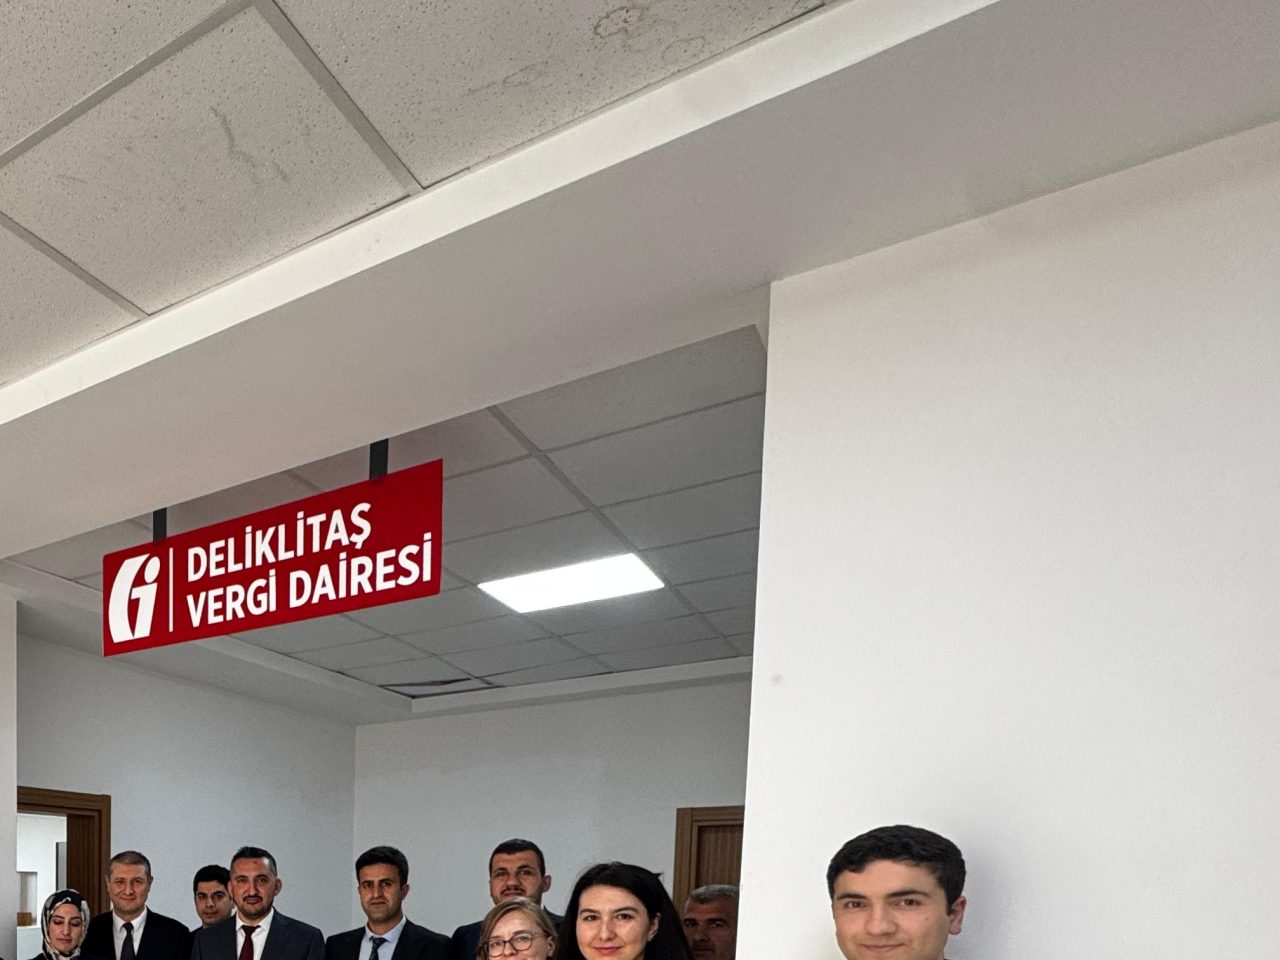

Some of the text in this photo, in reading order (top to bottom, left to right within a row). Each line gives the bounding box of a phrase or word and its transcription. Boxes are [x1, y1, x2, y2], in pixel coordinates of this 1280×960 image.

[186, 532, 433, 628] VERGİ DAİRESİ
[187, 502, 372, 583] DELİKLİTAŞ
